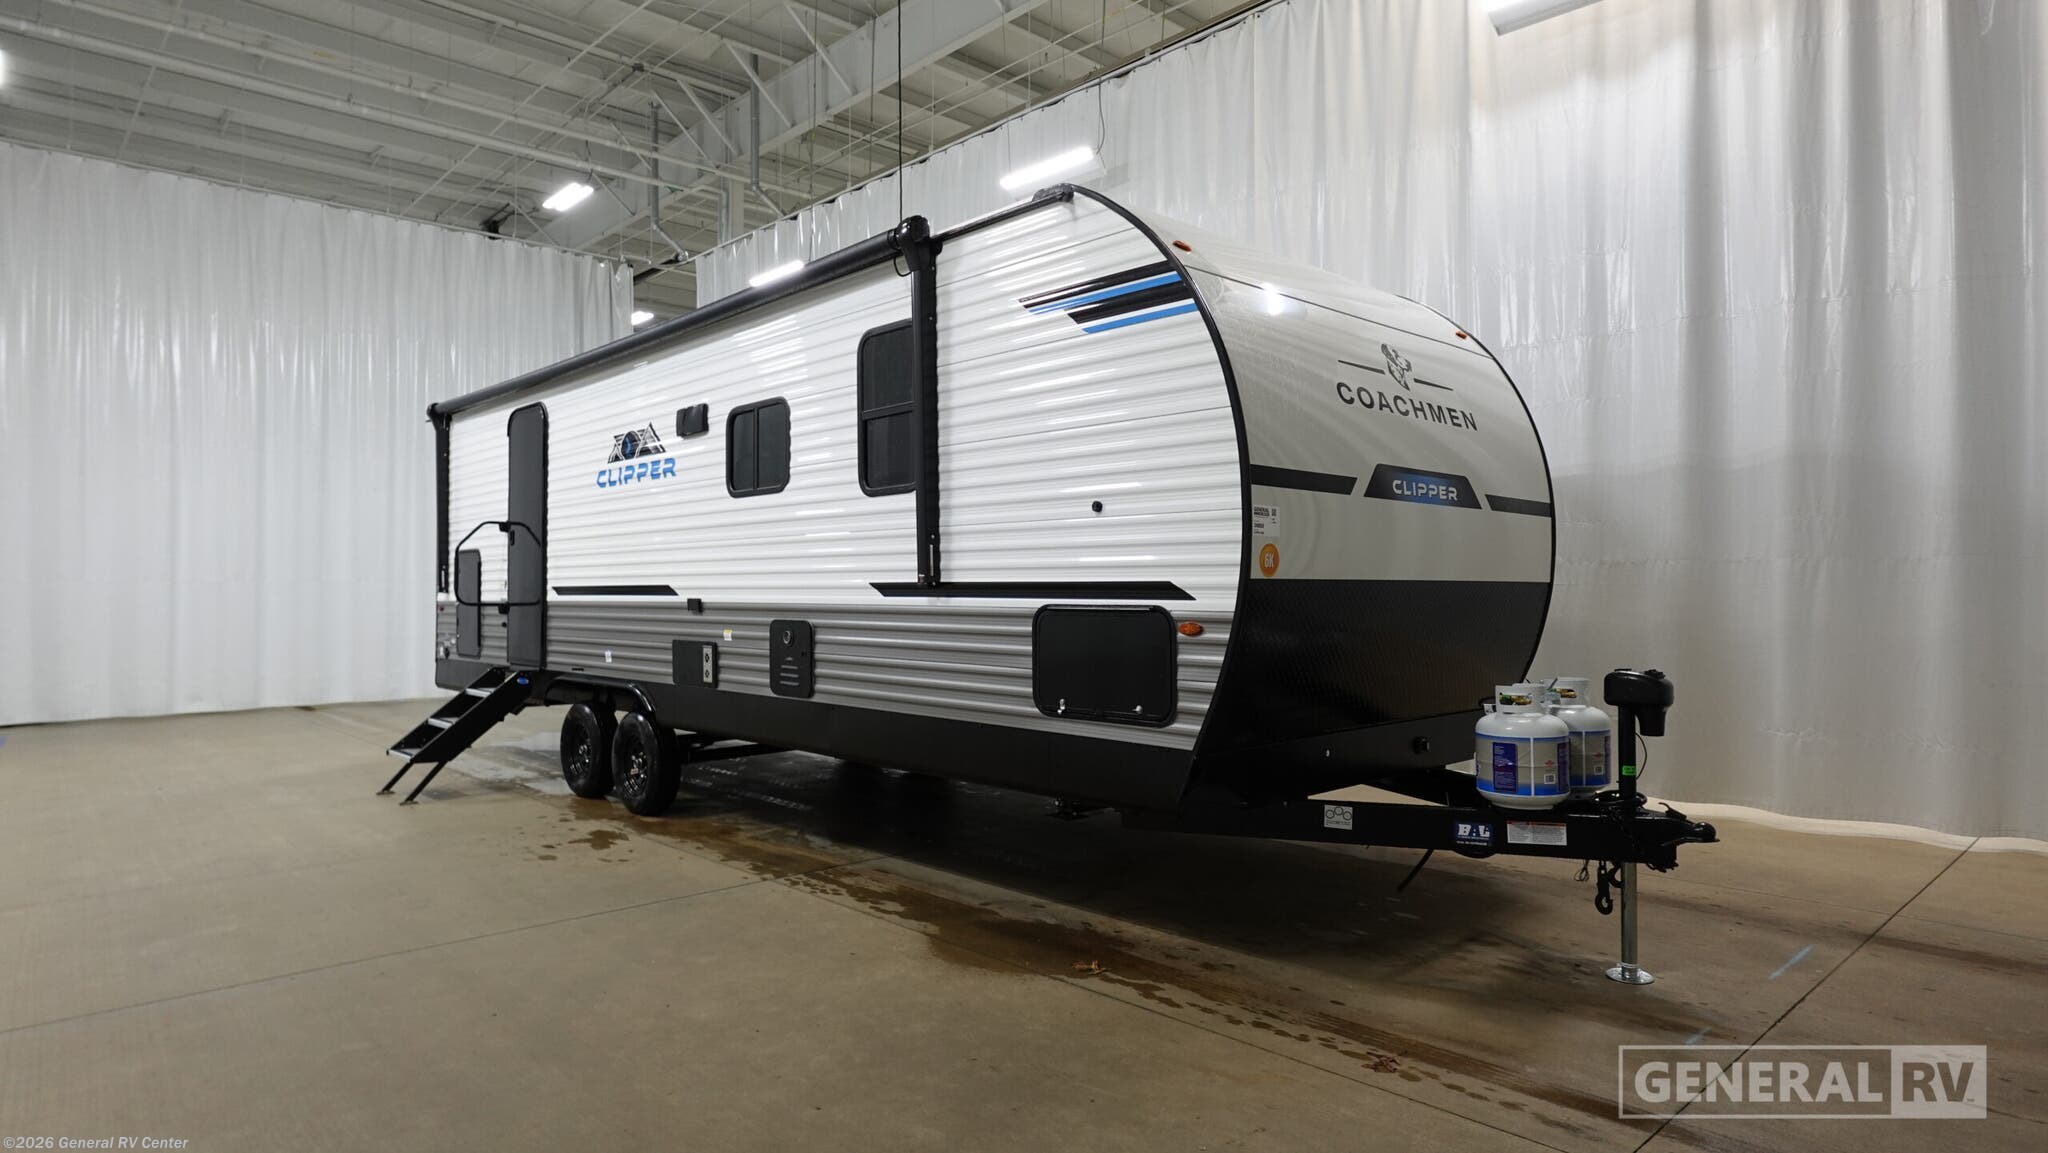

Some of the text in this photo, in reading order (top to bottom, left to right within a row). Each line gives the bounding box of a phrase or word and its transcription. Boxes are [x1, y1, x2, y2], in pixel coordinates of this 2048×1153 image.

[1336, 382, 1478, 431] COACHMEN
[596, 458, 676, 488] CLIPPER
[1392, 479, 1458, 500] CLIPPER
